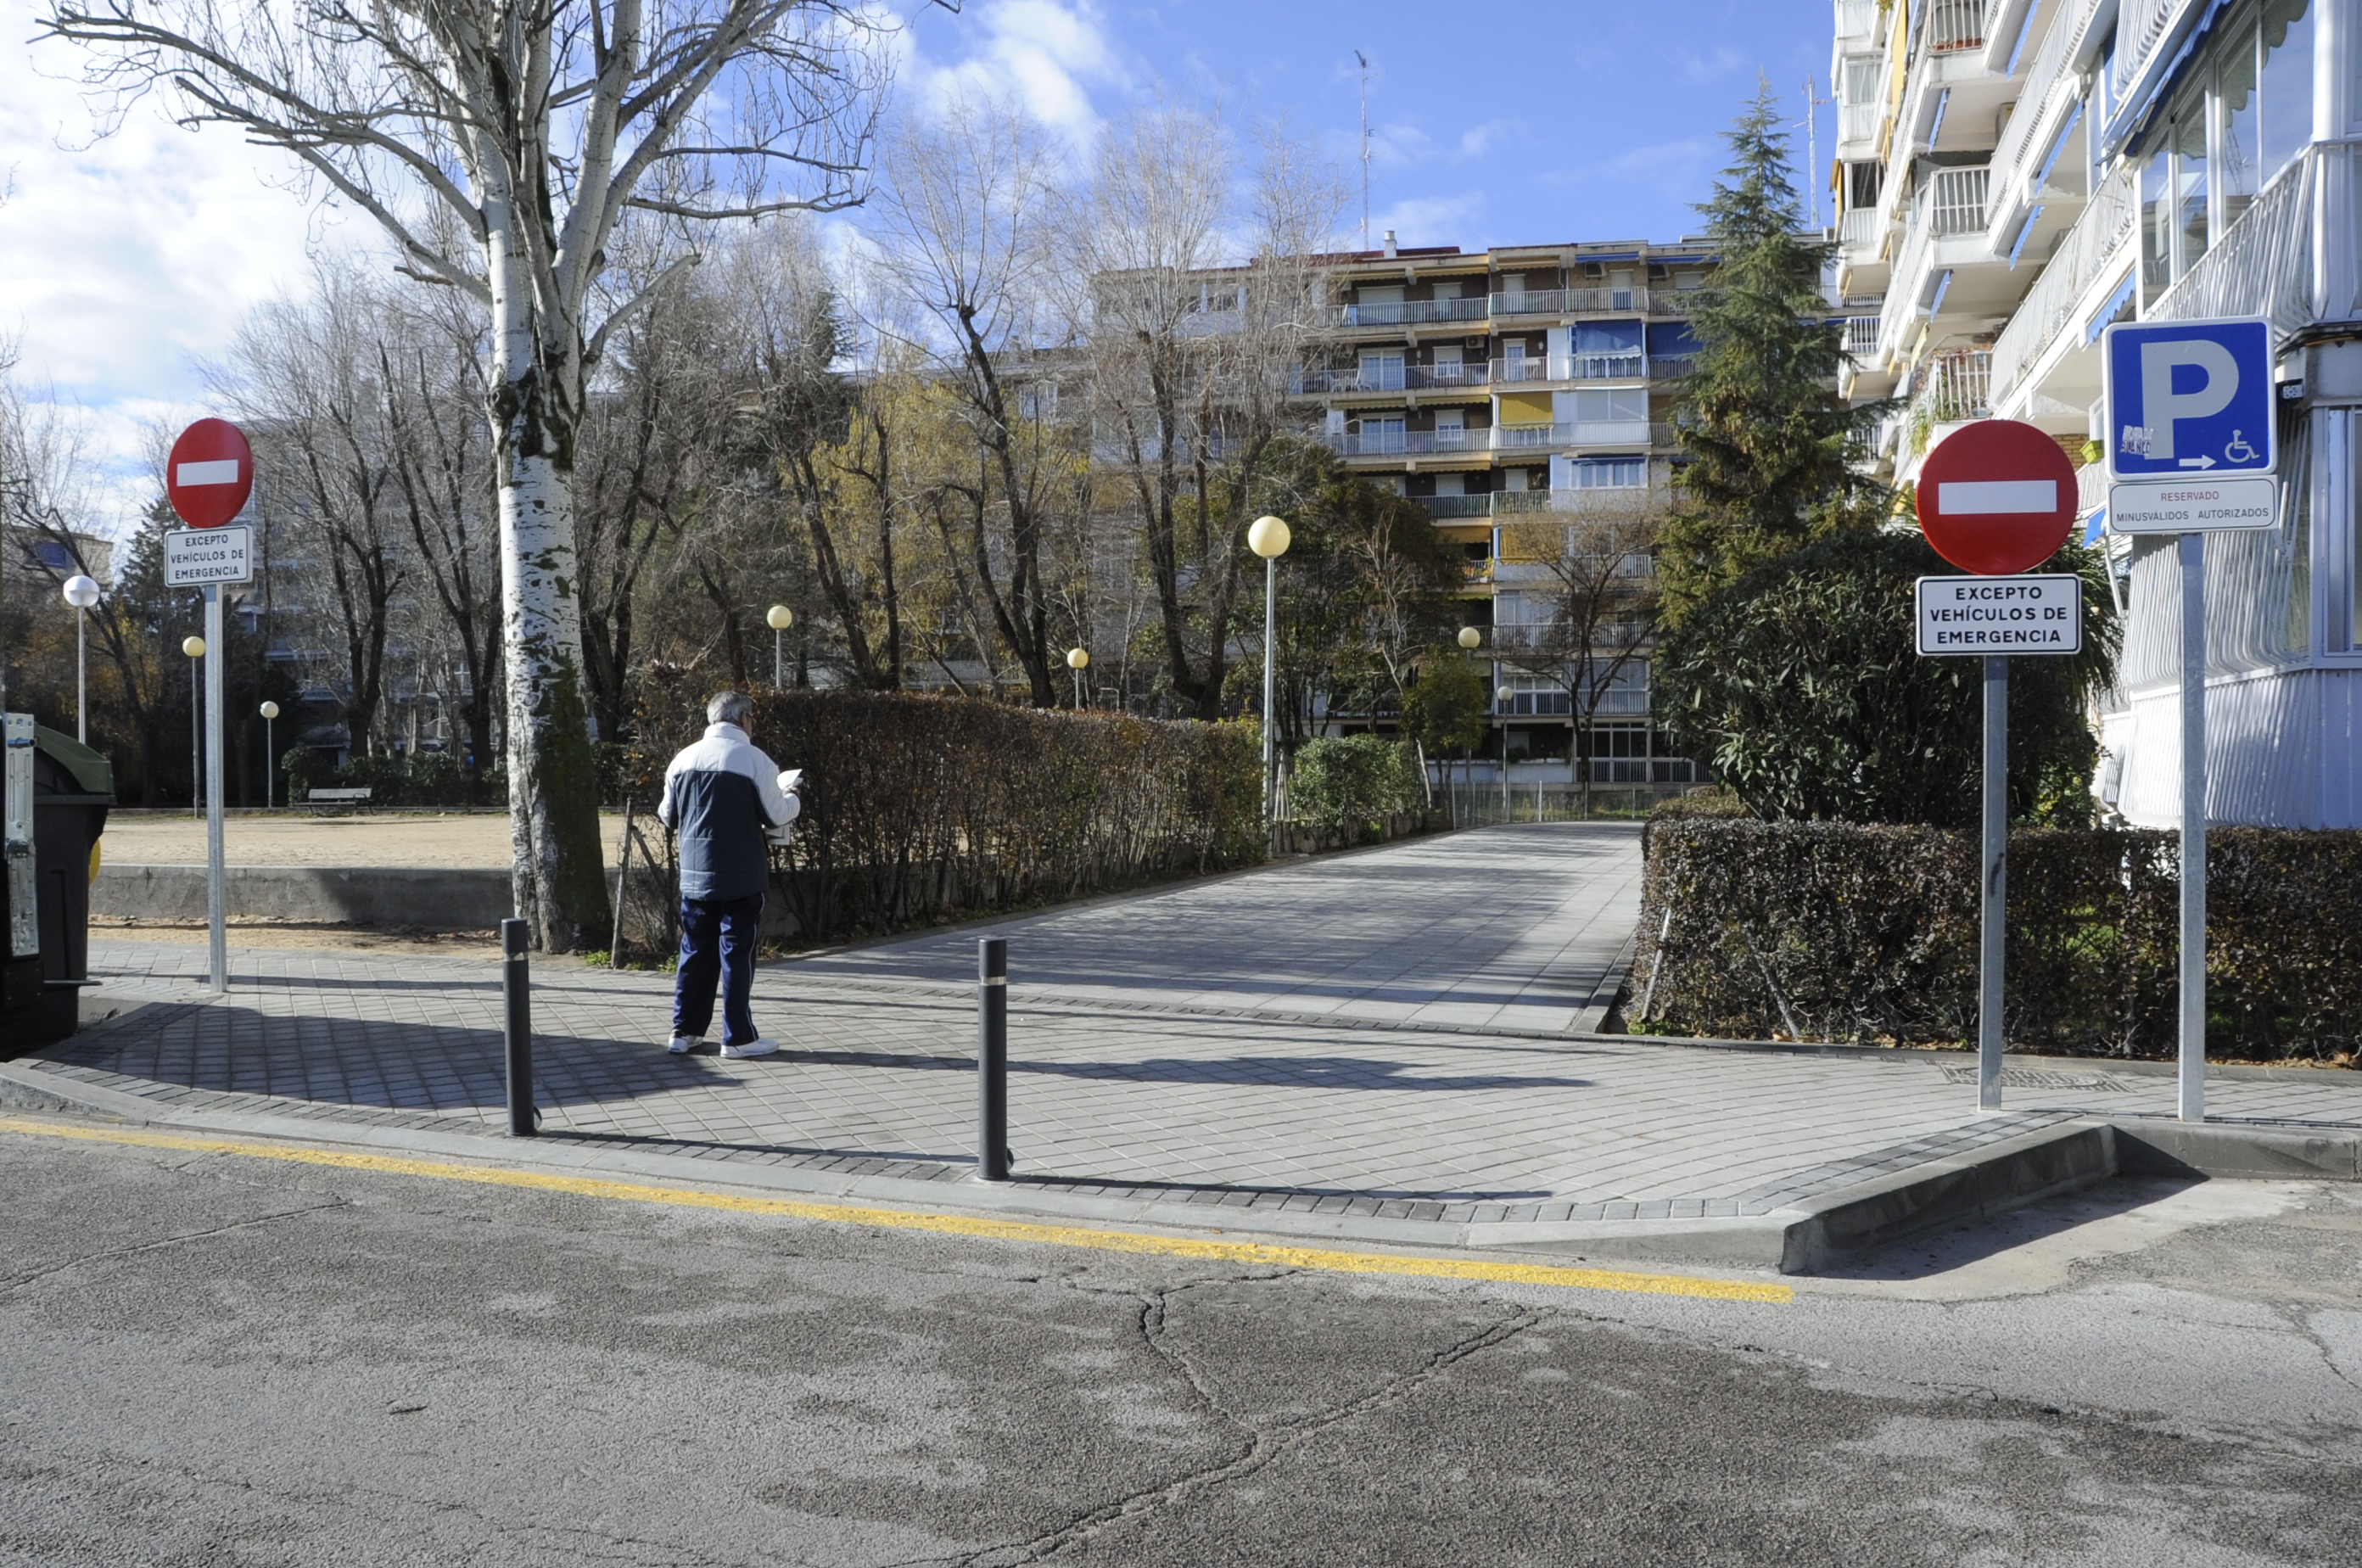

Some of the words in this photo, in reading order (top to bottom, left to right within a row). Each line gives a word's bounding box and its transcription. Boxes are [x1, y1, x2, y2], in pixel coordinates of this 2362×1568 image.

[2141, 339, 2239, 460] P
[2161, 490, 2219, 501] RESERVADO
[2116, 509, 2189, 522] MINUSVÁLIDOS
[2197, 507, 2270, 519] AUTORIZADOS
[185, 534, 228, 547] EXCEPTO
[171, 550, 226, 564] VEHÍCULOS
[231, 549, 243, 559] DE
[175, 565, 239, 580] EMERGENCIA
[1956, 586, 2042, 601] EXCEPTO
[1930, 605, 2036, 622] VEHÍCULOS
[2044, 607, 2068, 620] DE
[1937, 630, 2062, 644] EMERGENCIA
